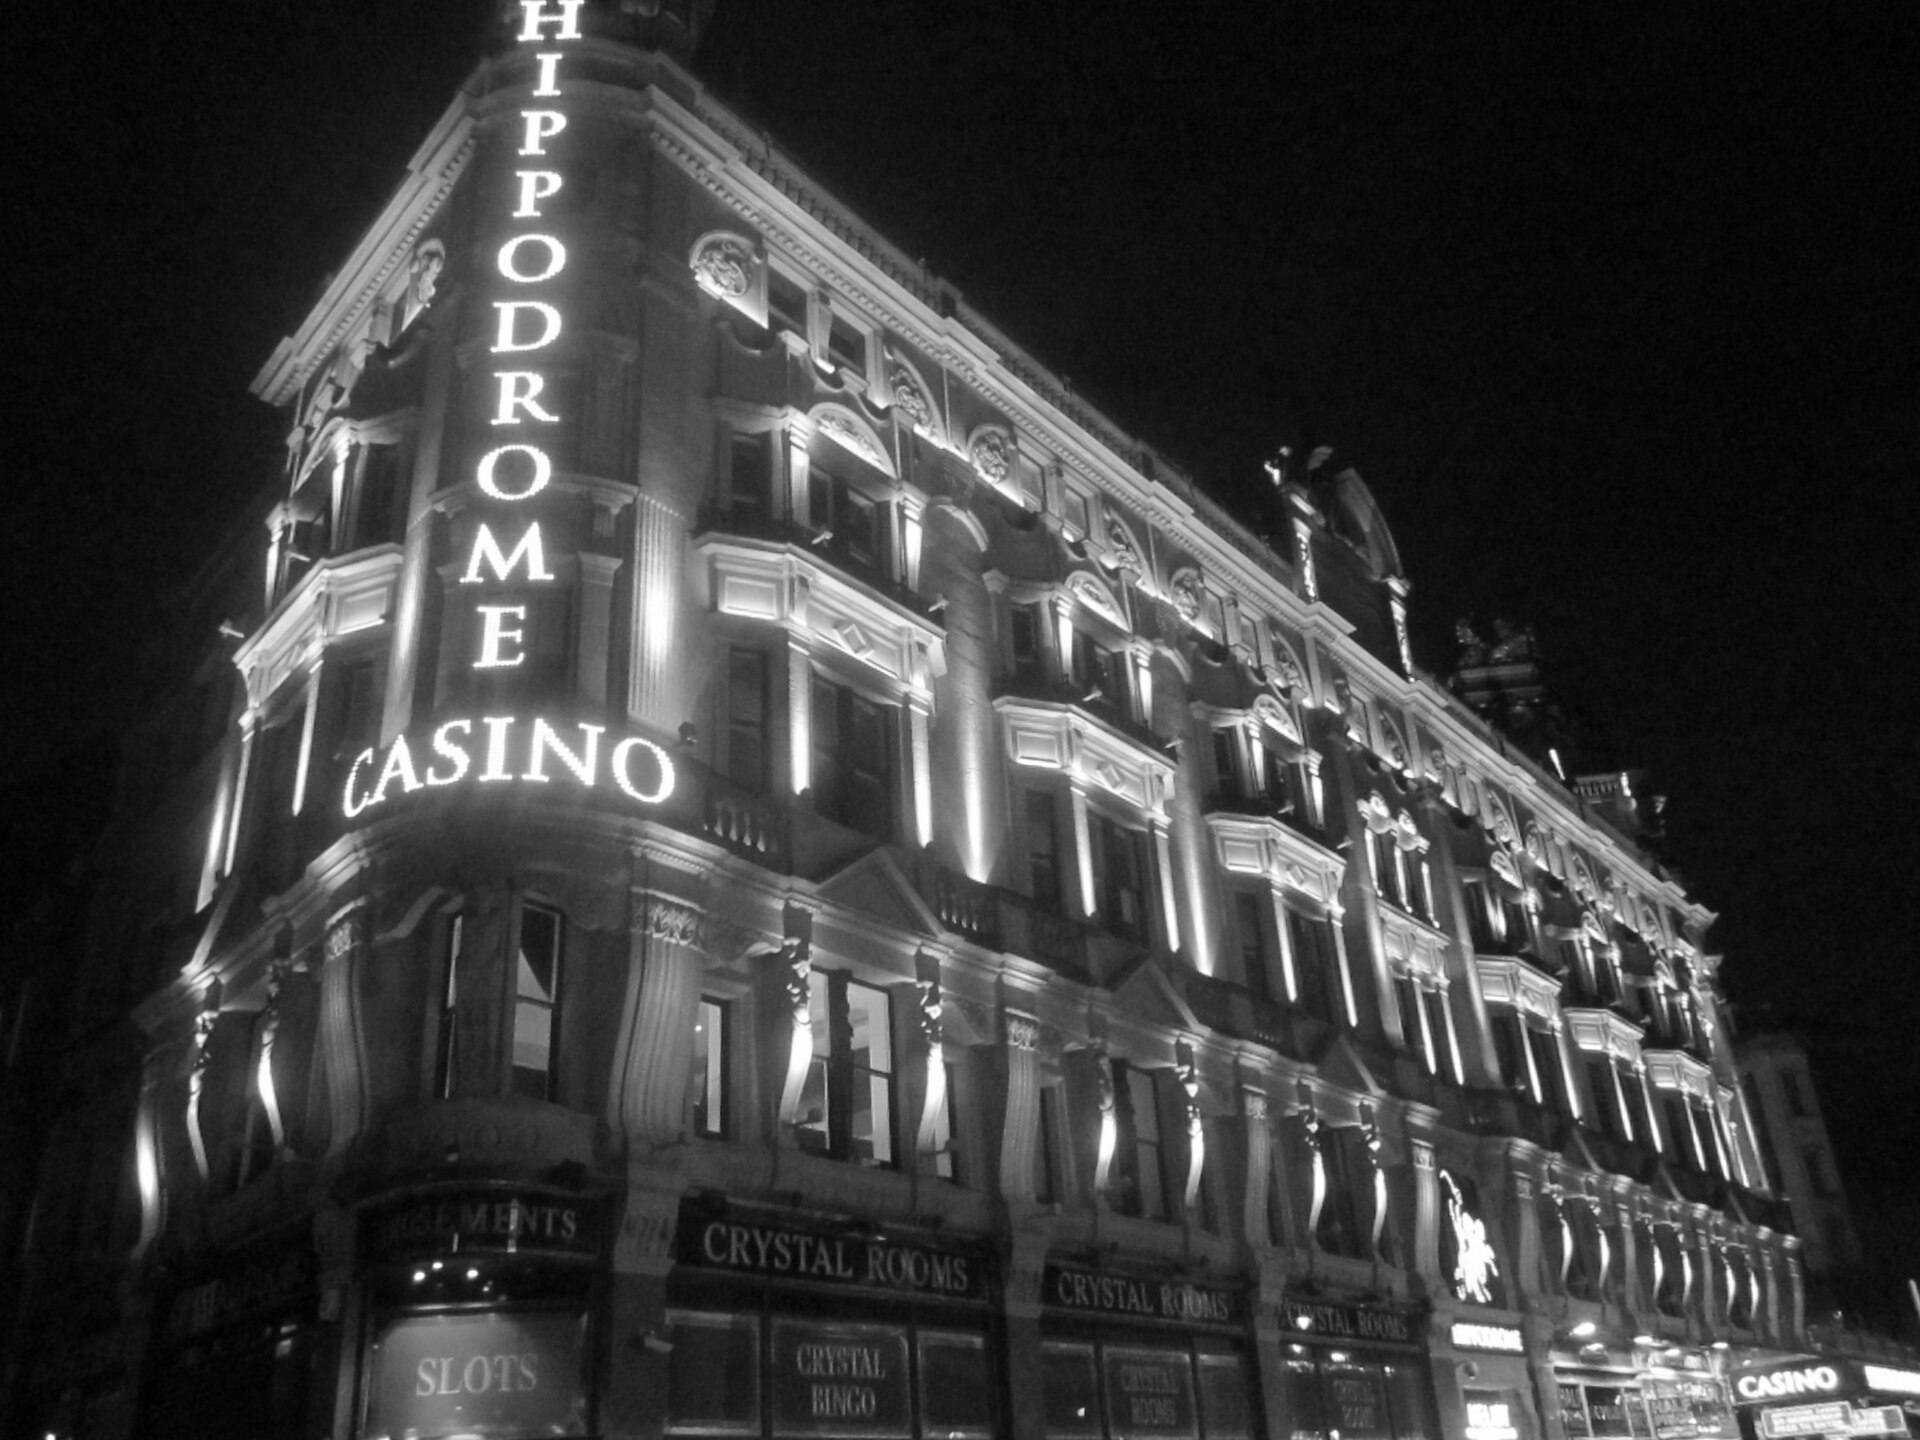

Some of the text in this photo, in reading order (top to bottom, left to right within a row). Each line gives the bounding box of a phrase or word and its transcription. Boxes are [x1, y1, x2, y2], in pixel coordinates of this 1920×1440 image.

[459, 0, 585, 669] HIPPODROME
[341, 717, 678, 820] CASINO
[704, 1222, 968, 1291] CRYSTAL ROOMS
[1058, 1271, 1228, 1320] CRYSTAL ROOMS
[1357, 1311, 1408, 1340] ROOMS
[416, 1353, 538, 1396] SLOTS
[797, 1343, 886, 1379] CRYSTAL
[1738, 1366, 1838, 1398] CASINO
[812, 1384, 876, 1417] BINGO
